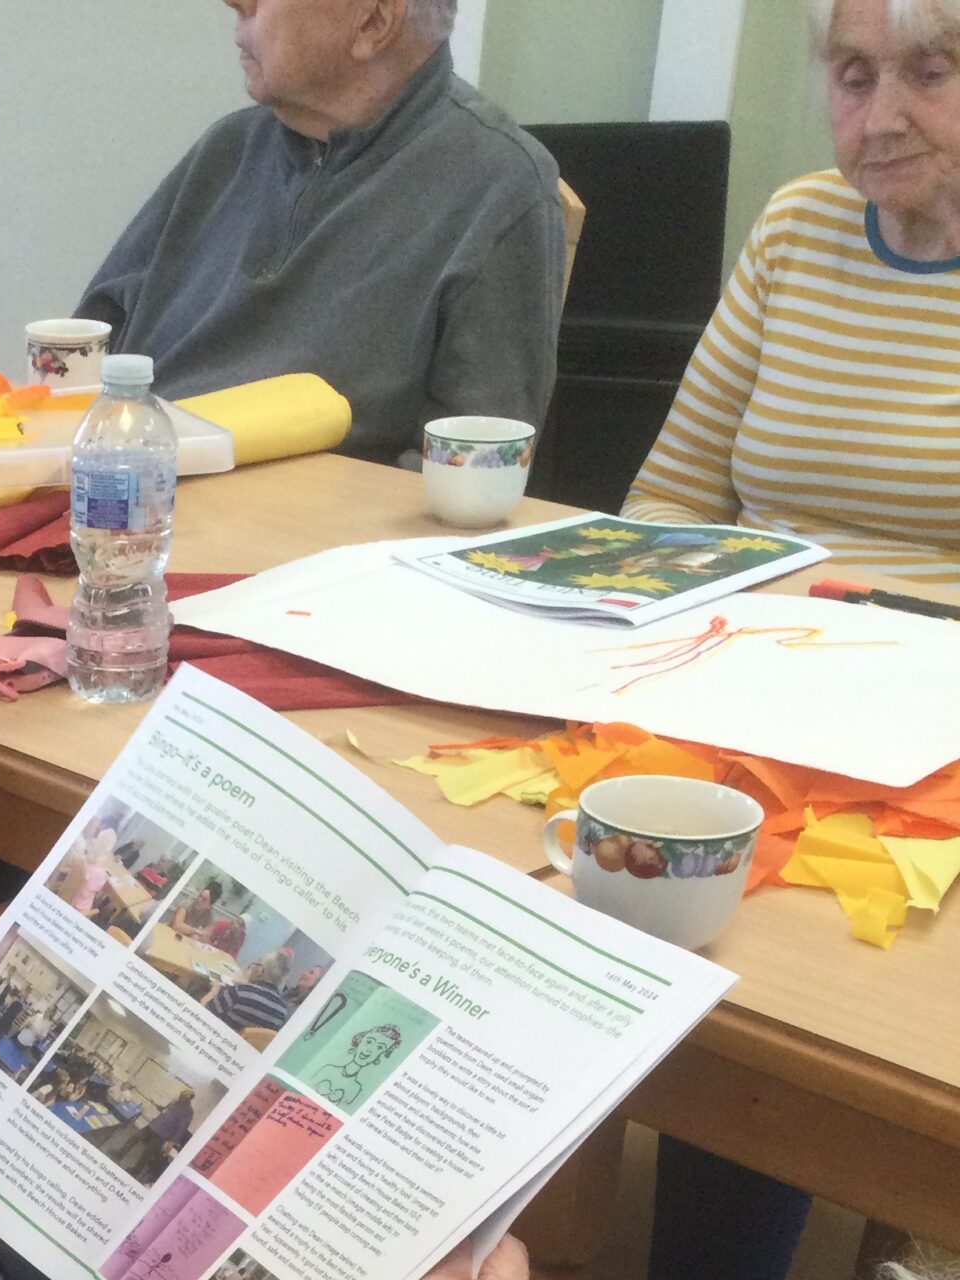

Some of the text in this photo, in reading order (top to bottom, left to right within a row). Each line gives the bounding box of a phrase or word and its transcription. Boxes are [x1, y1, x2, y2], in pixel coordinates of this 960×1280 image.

[208, 773, 255, 808] poem
[231, 838, 250, 854] role
[254, 833, 280, 858] Dean
[280, 856, 315, 887] visiting
[331, 895, 360, 923] Beech
[155, 986, 185, 1008] personal
[432, 976, 490, 1019] Winner
[149, 1008, 166, 1023] team
